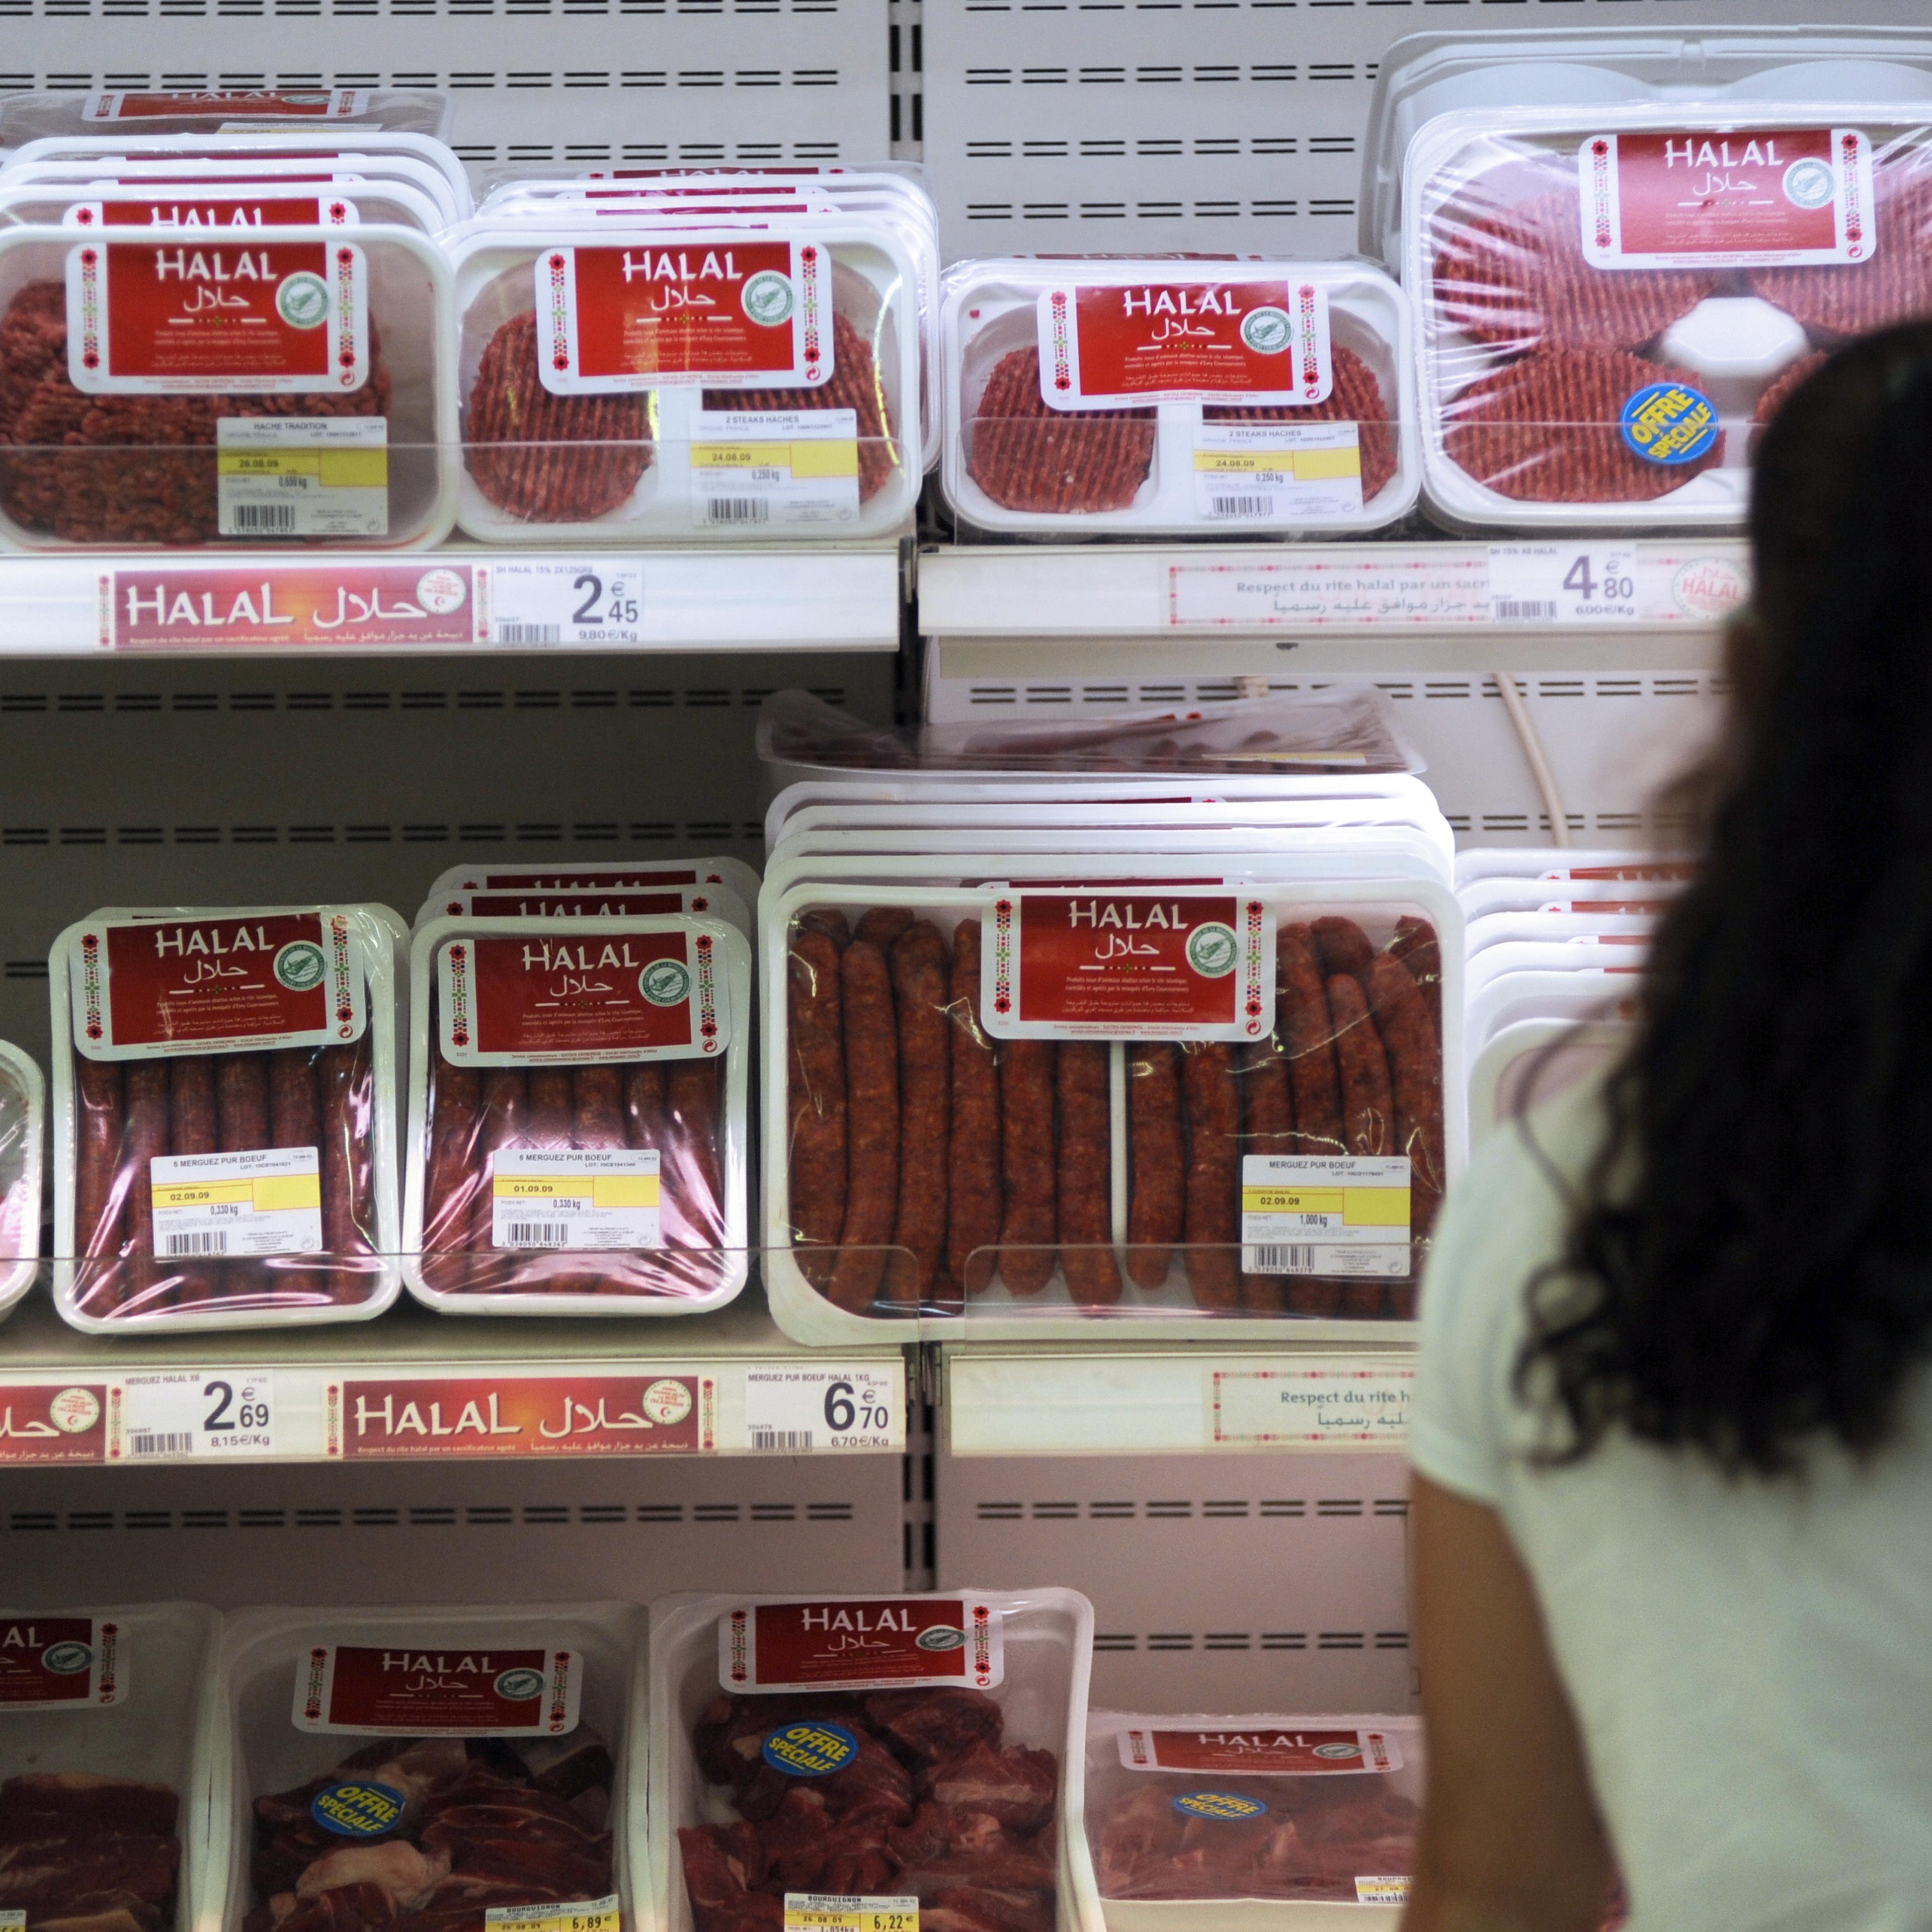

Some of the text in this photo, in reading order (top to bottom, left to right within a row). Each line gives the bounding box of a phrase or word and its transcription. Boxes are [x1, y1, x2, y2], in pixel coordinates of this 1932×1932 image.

[1664, 139, 1784, 169] HALAL
[1693, 173, 1757, 196] حلال
[156, 249, 277, 281] HALAL
[622, 251, 743, 282] HALAL
[183, 284, 250, 312] حلال
[651, 285, 715, 310] حلال
[1123, 289, 1242, 317] HALAL
[1152, 318, 1215, 340] حلال
[1632, 389, 1695, 443] OFFRE
[712, 453, 751, 461] 24.08.09
[1563, 555, 1598, 600] 4
[1605, 561, 1619, 575] €
[611, 581, 624, 597] €
[1237, 582, 1295, 595] Respect
[1300, 580, 1320, 592] du
[1326, 581, 1352, 592] rite
[1357, 579, 1394, 591] halal
[1400, 581, 1425, 594] par
[1430, 580, 1451, 590] un
[1603, 578, 1634, 599] 80
[125, 583, 296, 626] HALAL
[312, 586, 427, 628] حلال
[572, 574, 603, 624] 2
[608, 600, 638, 623] 45
[1068, 900, 1188, 929] HALAL
[155, 926, 275, 958] HALAL
[1095, 933, 1160, 959] حلال
[522, 943, 639, 972] HALAL
[184, 959, 248, 984] حلال
[550, 975, 613, 997] حلال
[180, 1158, 219, 1167] MERGUEZ
[221, 1157, 237, 1165] PUR
[239, 1154, 267, 1163] BOEUF
[1269, 1161, 1308, 1169] MERGUEZ
[1329, 1161, 1356, 1169] BOEUF
[170, 1192, 210, 1201] 02.09.09
[573, 1198, 581, 1210] kg
[1260, 1197, 1300, 1205] 02.09.09
[230, 1204, 238, 1216] kg
[1319, 1214, 1327, 1228] kg
[125, 1376, 160, 1384] MERGUEZ
[242, 1387, 255, 1401] €
[862, 1390, 876, 1404] €
[1281, 1391, 1338, 1405] Respect
[1344, 1391, 1364, 1403] du
[1370, 1391, 1396, 1403] rite
[203, 1381, 235, 1431] 2
[239, 1404, 269, 1428] 69
[354, 1392, 522, 1436] HALAL
[539, 1396, 653, 1438] حلال
[824, 1382, 856, 1431] 6
[859, 1406, 889, 1429] 70
[358, 1446, 384, 1454] Respect
[801, 1608, 917, 1632] HALAL
[2, 1626, 44, 1648] AL
[828, 1635, 890, 1652] حلال
[382, 1652, 498, 1674] HALAL
[406, 1676, 468, 1691] حلال
[786, 1727, 850, 1761] OFFRE
[1198, 1734, 1312, 1748] HALAL
[769, 1737, 837, 1772] SPÉCIALE
[317, 1794, 384, 1833] SPÉCIALE
[336, 1786, 398, 1824] OFFRE
[1196, 1793, 1259, 1814] OFFRE
[573, 1917, 601, 1931] 6,89
[874, 1915, 903, 1930] 6,22
